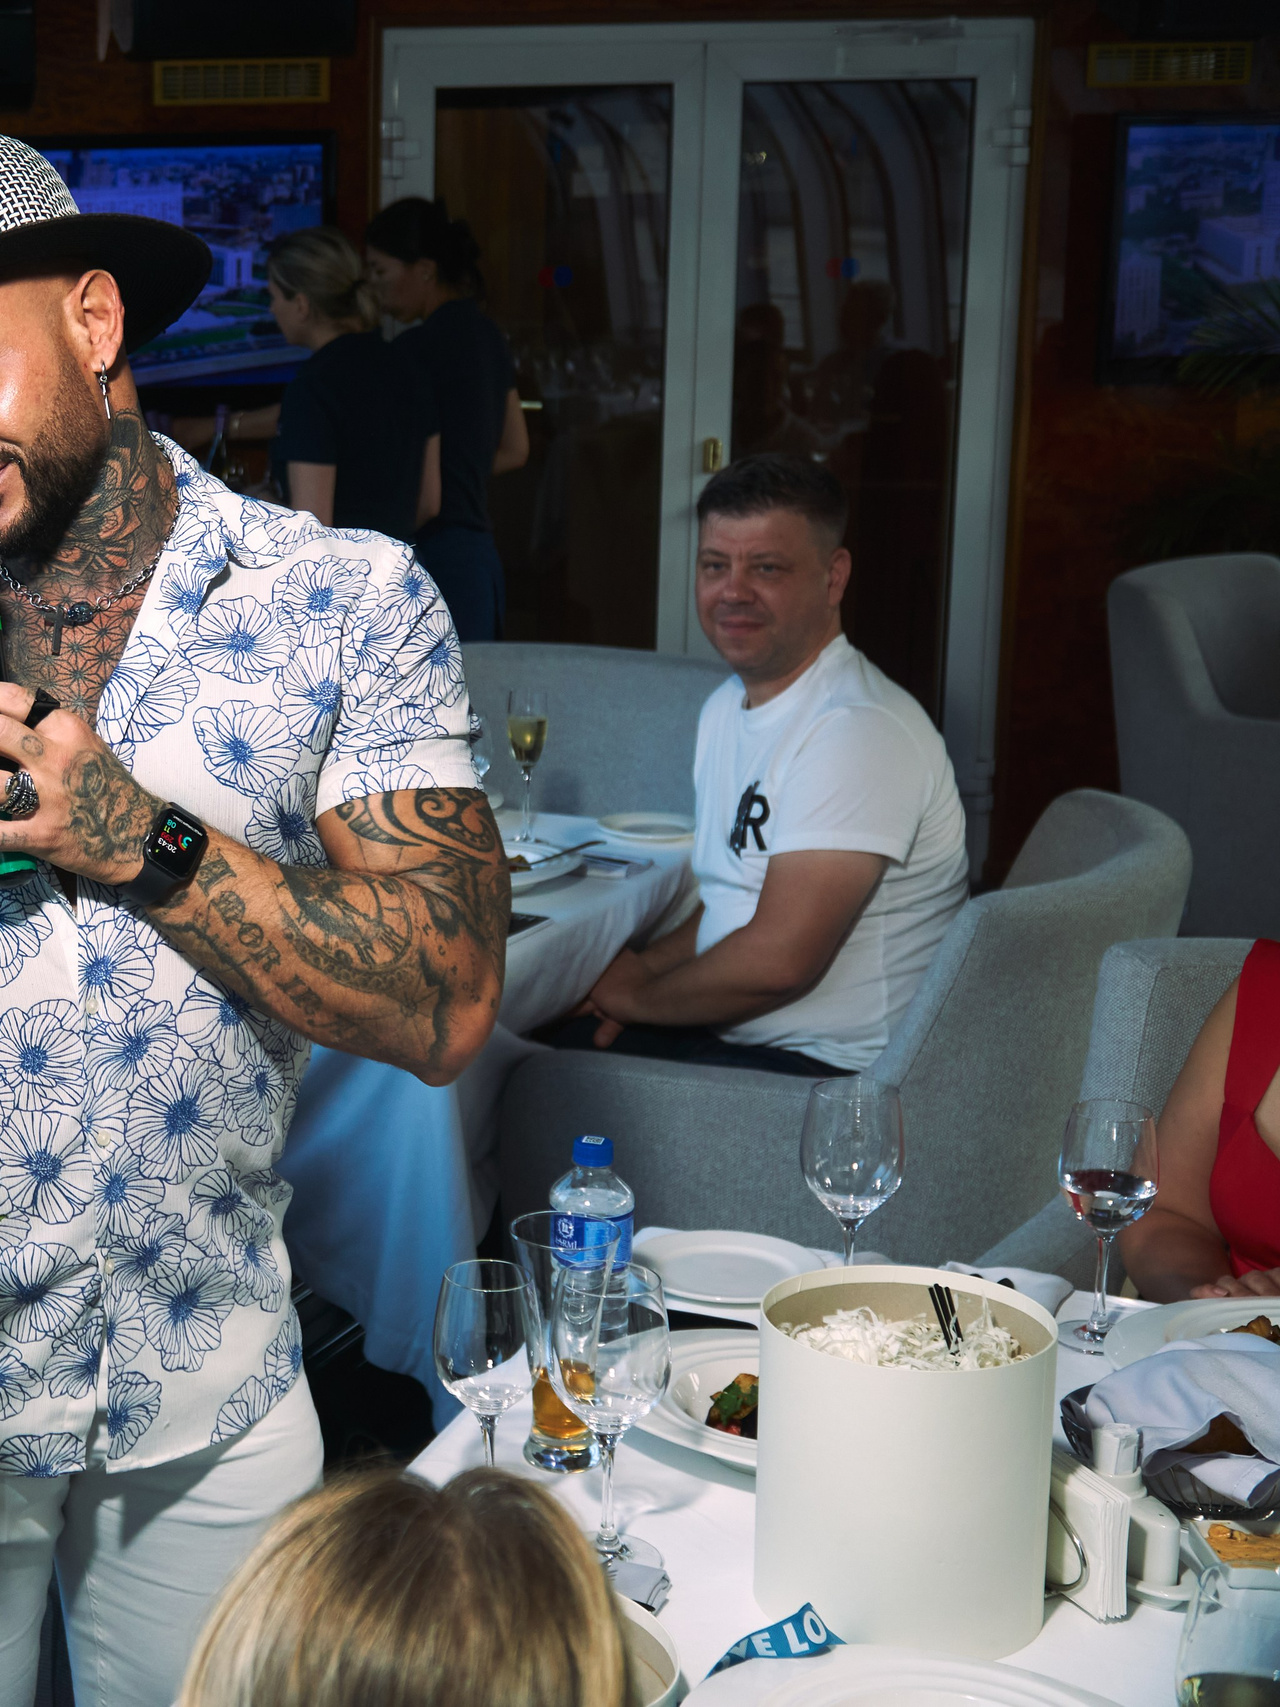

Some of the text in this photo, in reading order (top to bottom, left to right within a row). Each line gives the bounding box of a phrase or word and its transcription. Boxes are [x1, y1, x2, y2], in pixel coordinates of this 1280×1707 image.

[163, 825, 170, 833] 11
[166, 819, 177, 829] 08
[161, 831, 174, 843] 299
[158, 837, 177, 854] 20:43
[783, 1610, 827, 1654] LO
